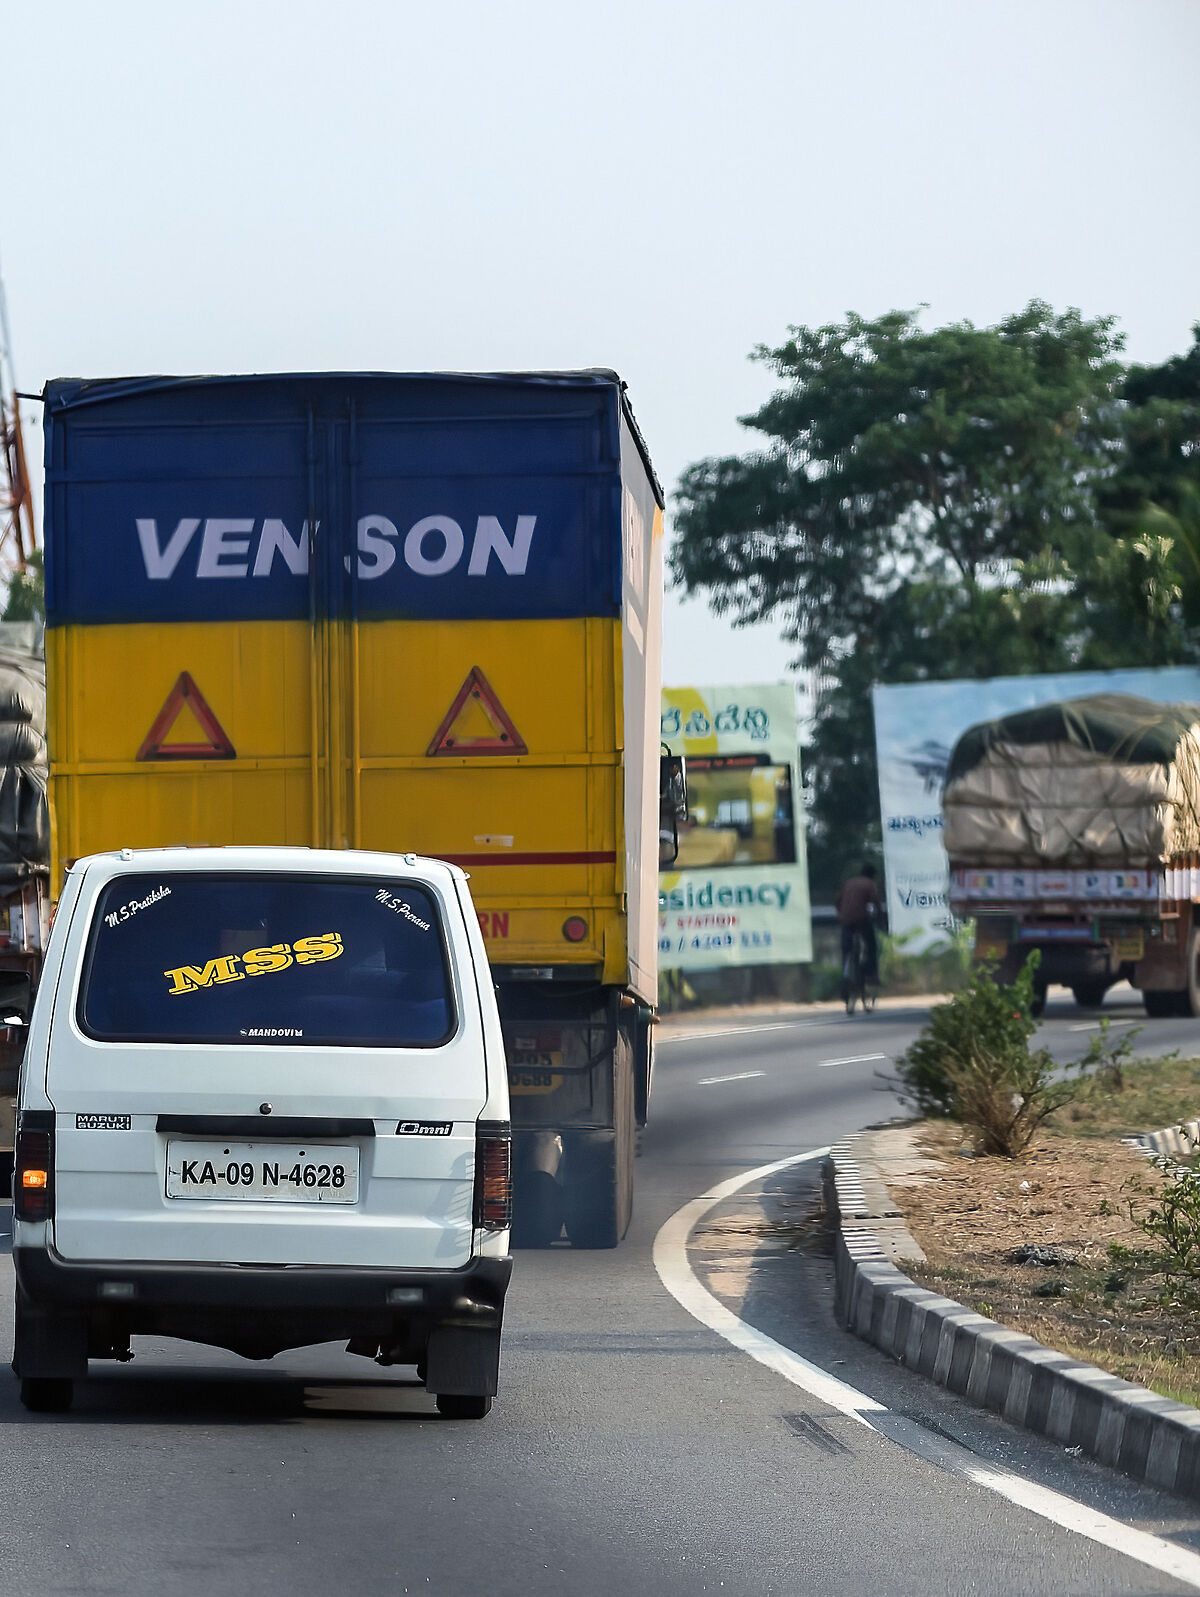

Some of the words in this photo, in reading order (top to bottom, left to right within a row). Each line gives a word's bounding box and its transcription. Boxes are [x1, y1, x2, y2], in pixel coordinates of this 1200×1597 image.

[164, 932, 345, 995] MSS
[399, 1122, 451, 1134] Omni
[181, 1160, 254, 1185] KA-09
[262, 1162, 346, 1188] N-4628
